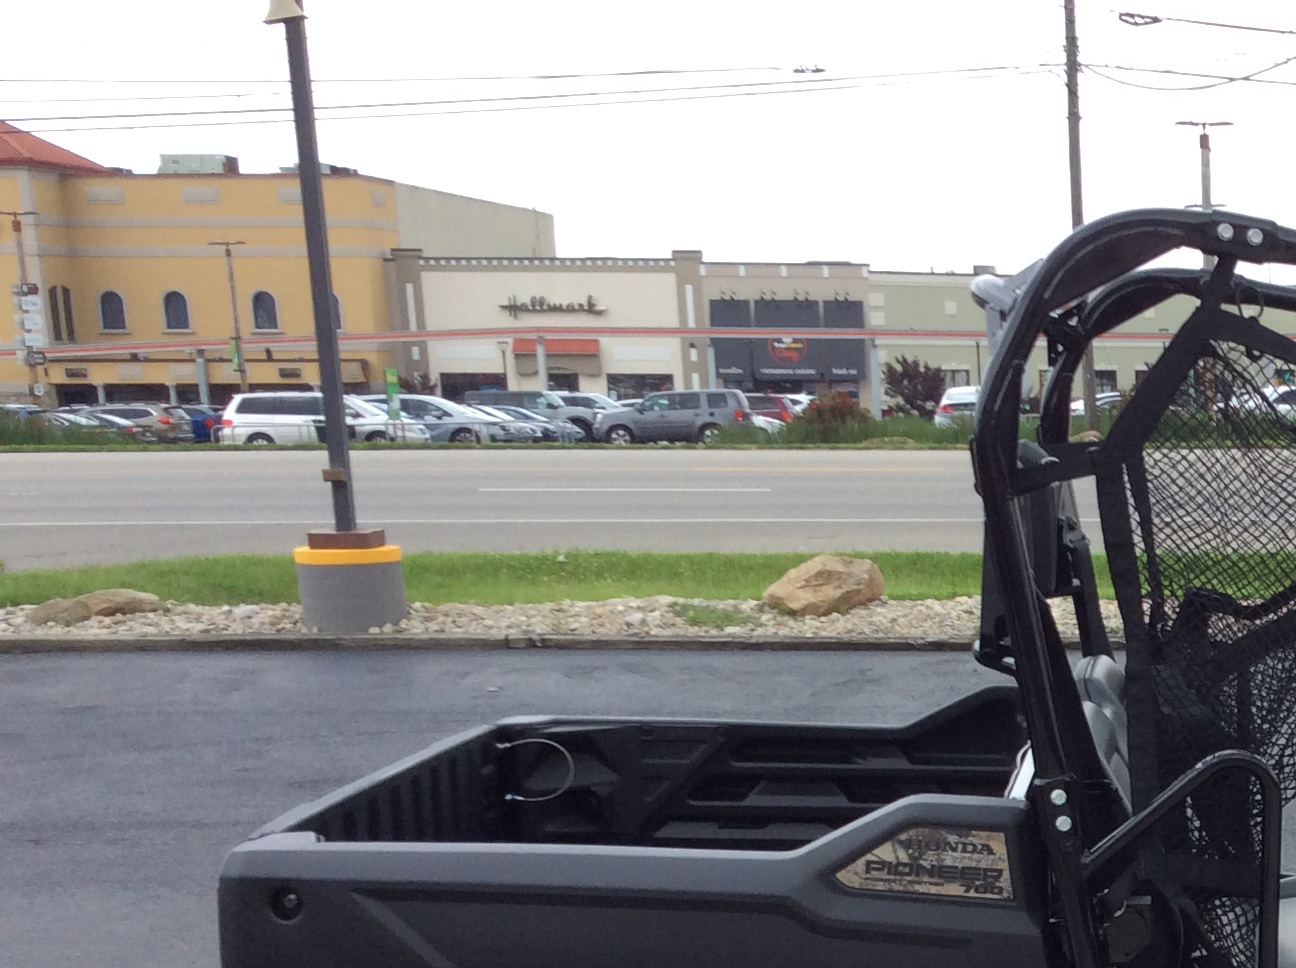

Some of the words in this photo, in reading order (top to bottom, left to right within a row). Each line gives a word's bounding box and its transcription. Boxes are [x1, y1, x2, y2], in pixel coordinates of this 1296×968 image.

[498, 294, 606, 320] Hallmark
[905, 838, 996, 855] HONDA
[865, 860, 1004, 882] PIONEER
[960, 883, 1004, 895] 700
